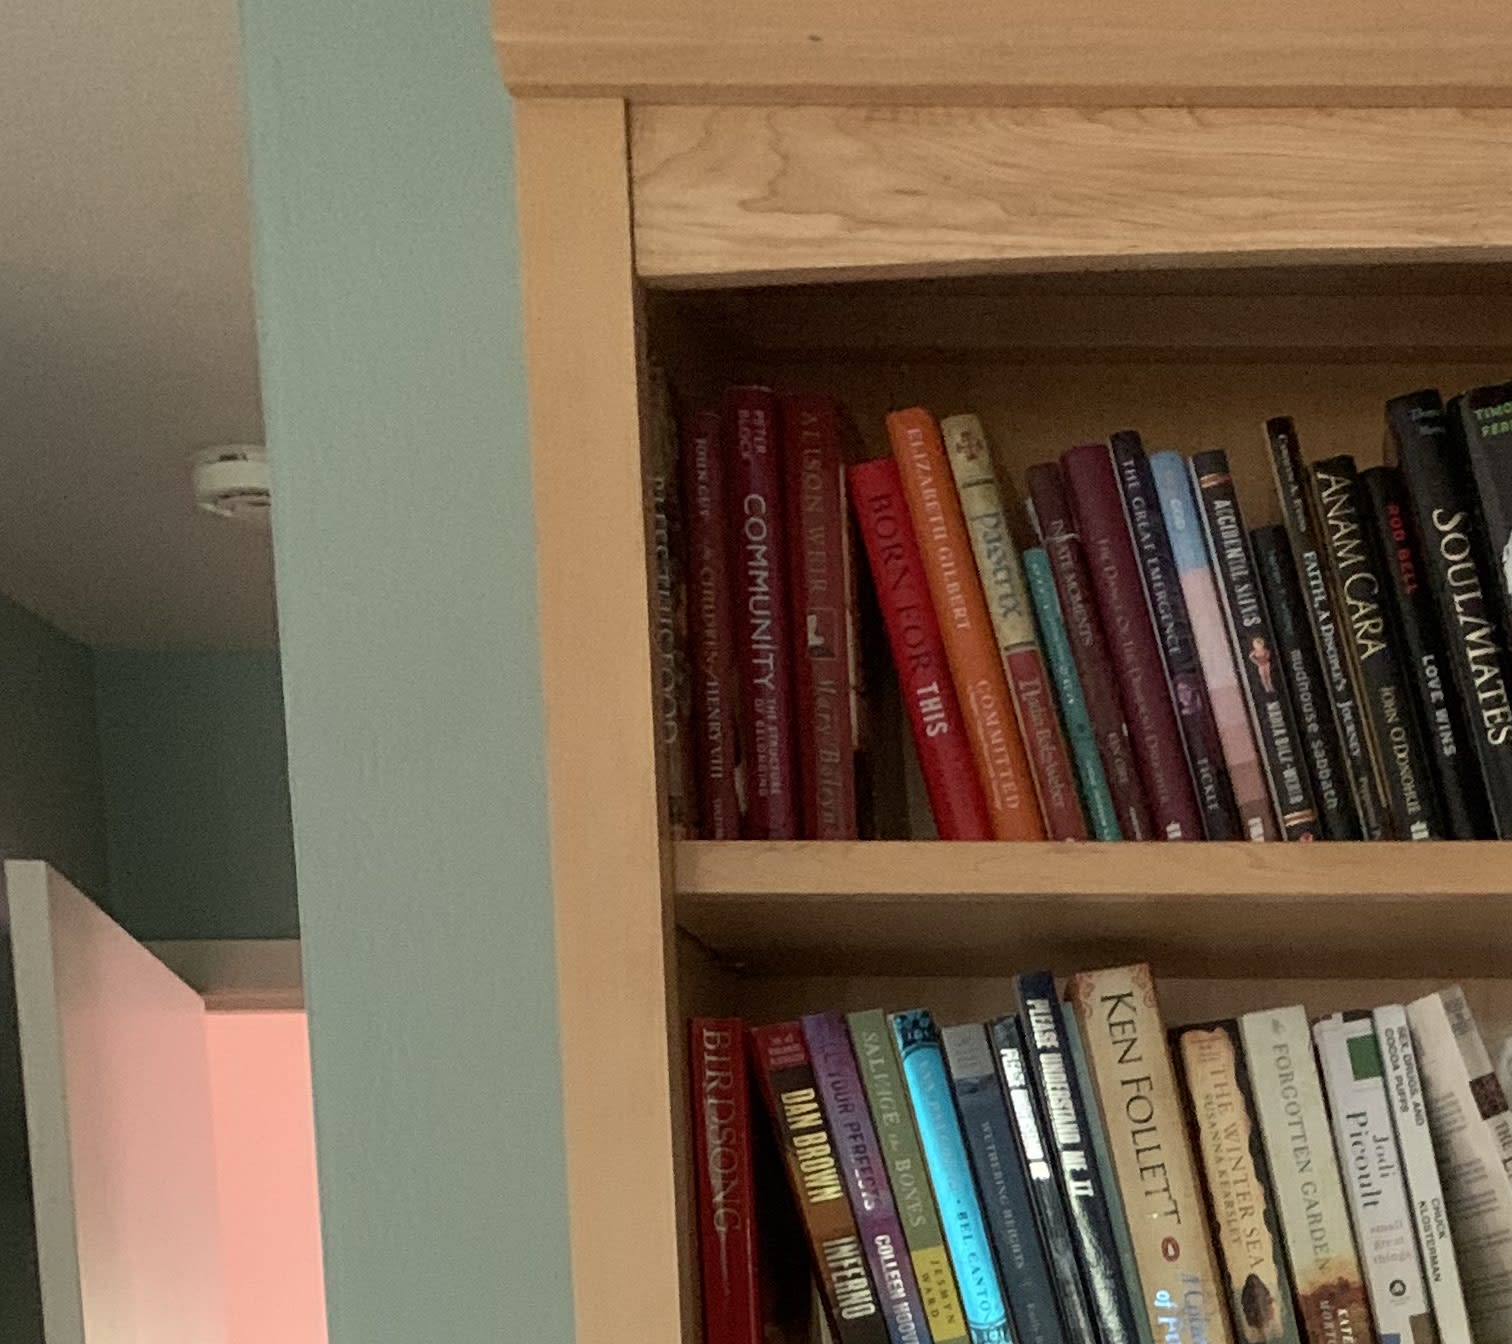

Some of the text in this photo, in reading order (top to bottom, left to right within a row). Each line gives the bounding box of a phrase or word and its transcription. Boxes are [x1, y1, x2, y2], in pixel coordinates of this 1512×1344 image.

[744, 493, 775, 690] COMMUNITY
[906, 428, 968, 630] ELIZABETH GILBERT
[1123, 459, 1181, 657] THE GREAT EMERGENCE
[1317, 472, 1385, 660] ANAM CARA
[897, 603, 927, 675] FOR
[916, 682, 947, 737] THIS
[1290, 649, 1338, 810] mudhouse sabbath
[1422, 655, 1455, 757] LOVE WINS
[977, 680, 1020, 810] COMMITTED
[702, 1027, 740, 1232] BIRDSONG
[780, 1088, 843, 1203] DAN BROWN
[827, 1071, 852, 1115] YOUR
[1100, 991, 1181, 1224] KEN FOLLETT
[1272, 1043, 1331, 1271] FORGOTTEN GARDEN
[1344, 1110, 1378, 1207] Picoult
[1372, 1133, 1394, 1179] Jodi
[1492, 1120, 1512, 1151] THE
[896, 1159, 925, 1227] BONES
[1219, 1122, 1263, 1268] WINTER SEA
[822, 1235, 875, 1319] INFERNO
[875, 1234, 903, 1299] COLLEEN
